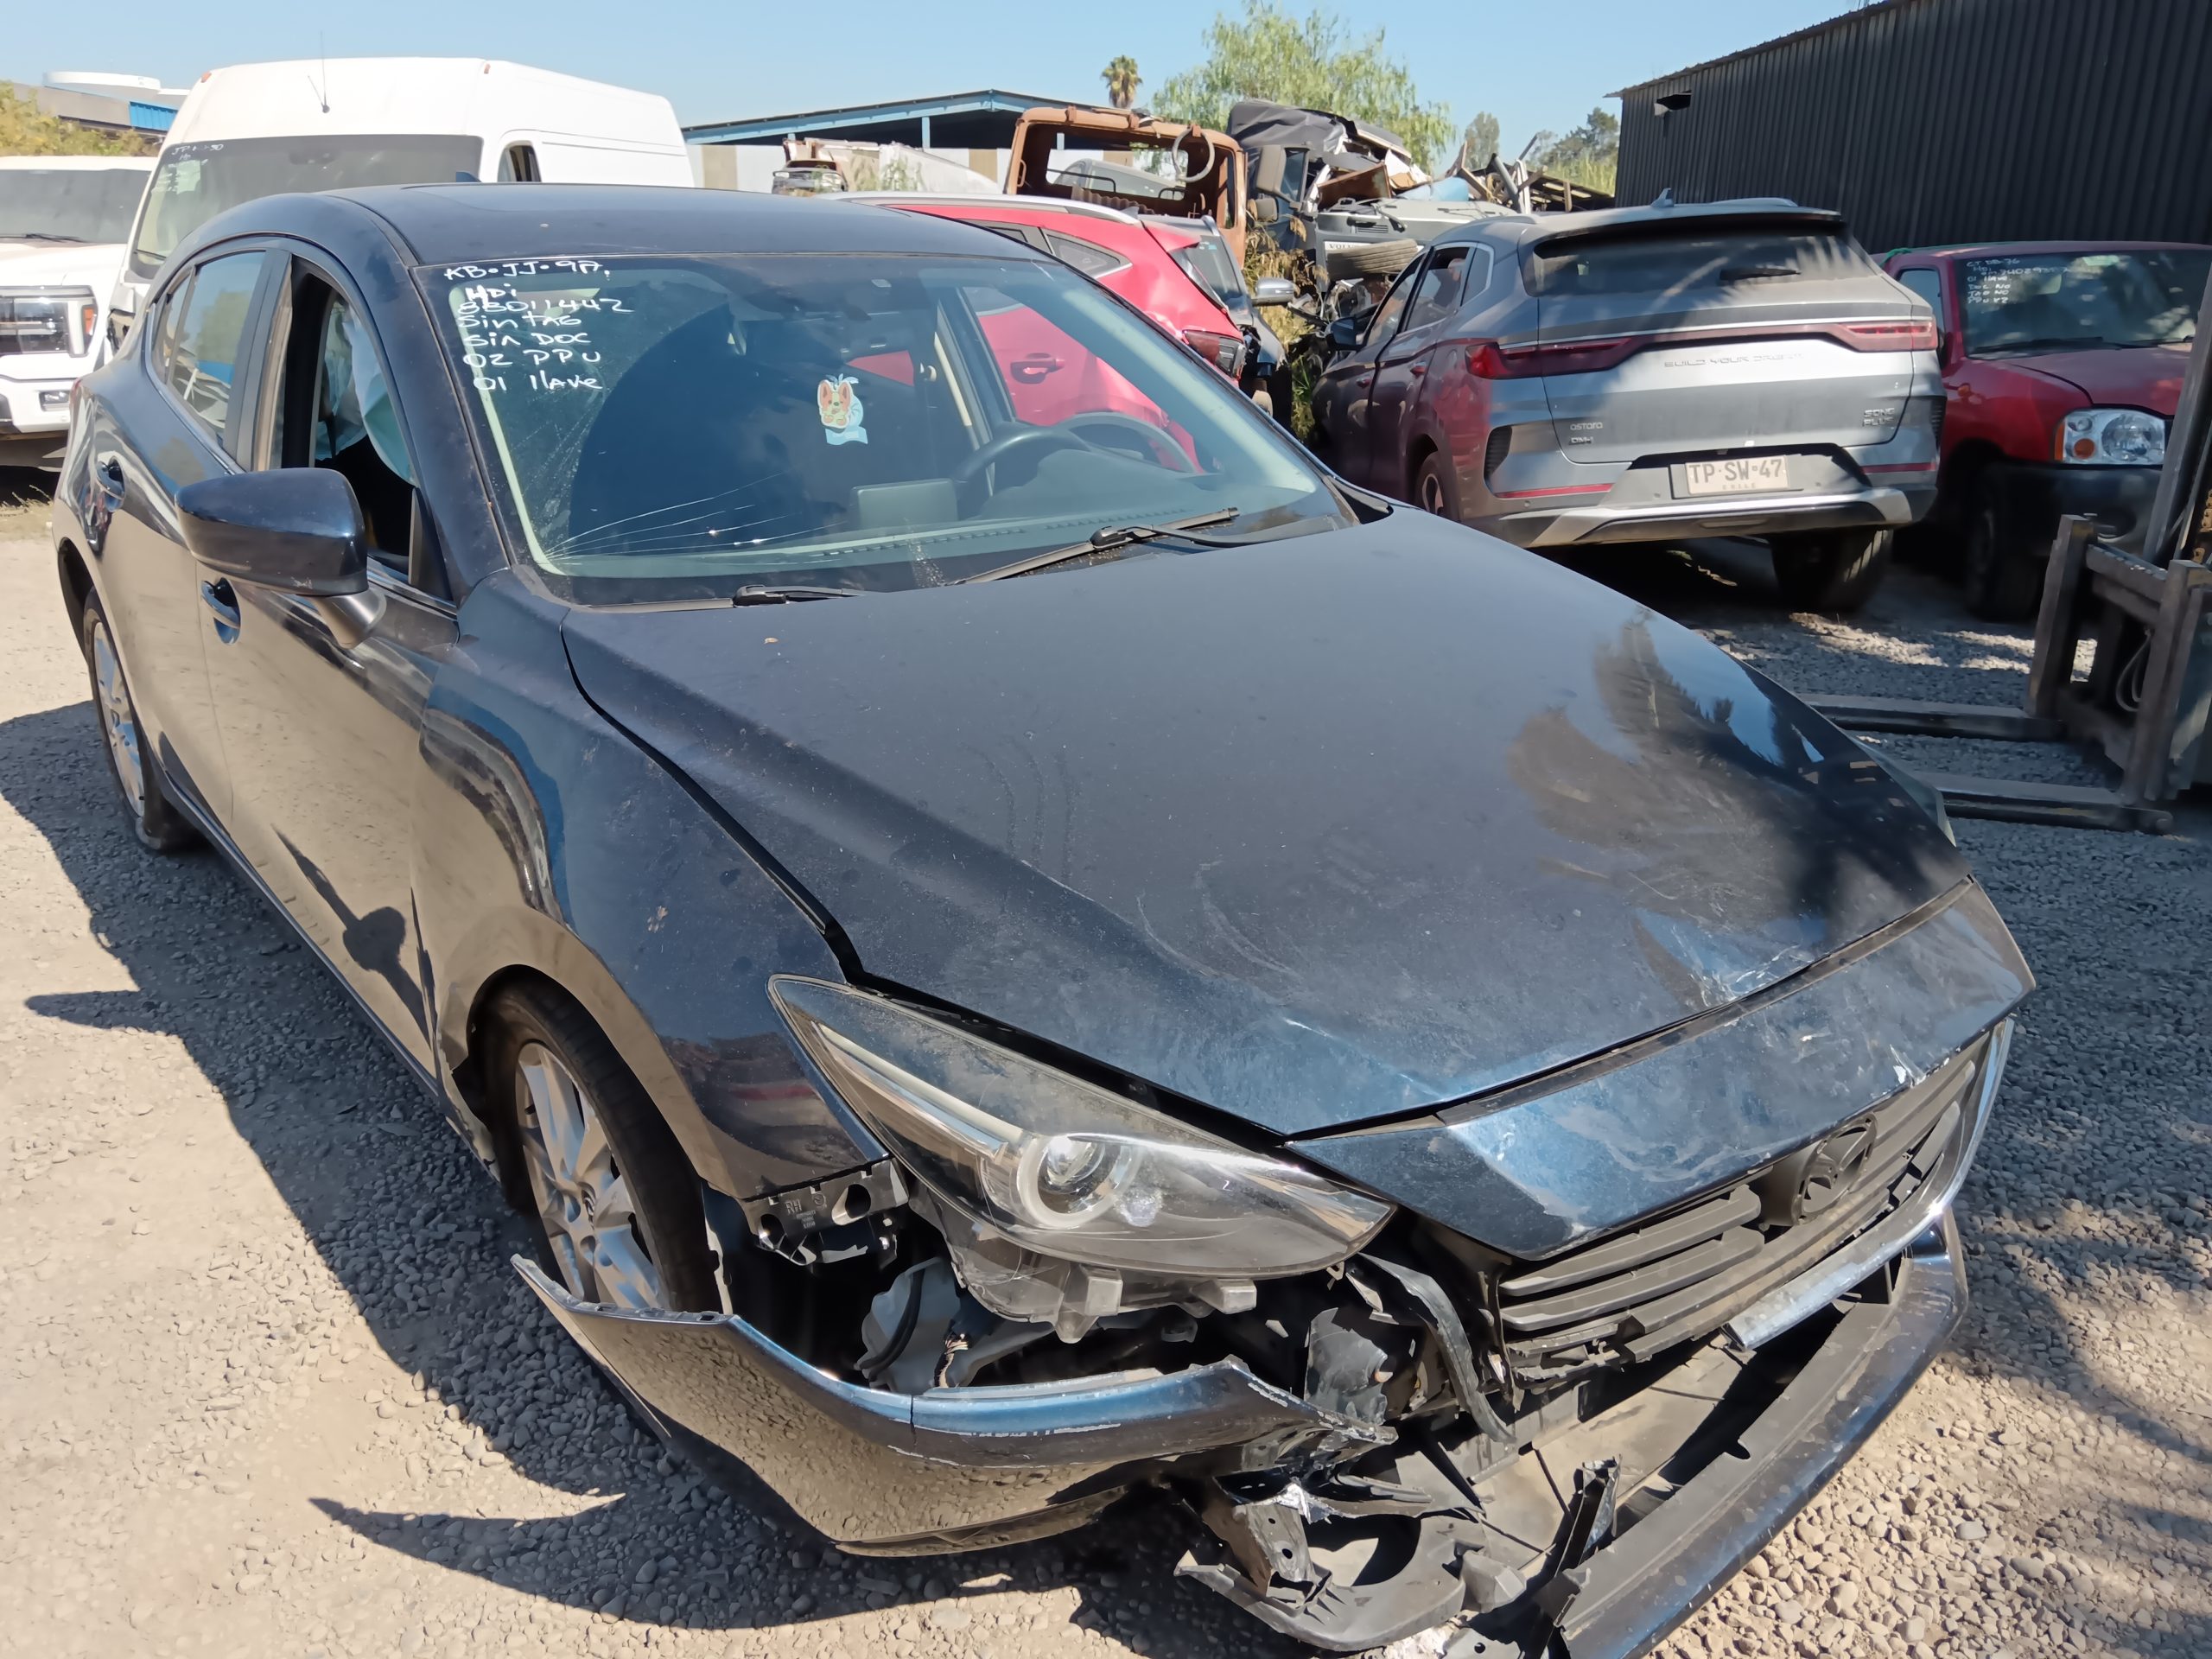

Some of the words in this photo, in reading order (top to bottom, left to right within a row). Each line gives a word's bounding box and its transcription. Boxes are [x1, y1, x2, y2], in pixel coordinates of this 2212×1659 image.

[530, 332, 593, 346] DOC
[1663, 359, 1707, 368] BUILD
[1709, 355, 1750, 365] YOUR
[1864, 407, 1895, 417] SONG
[785, 1198, 803, 1215] RH
